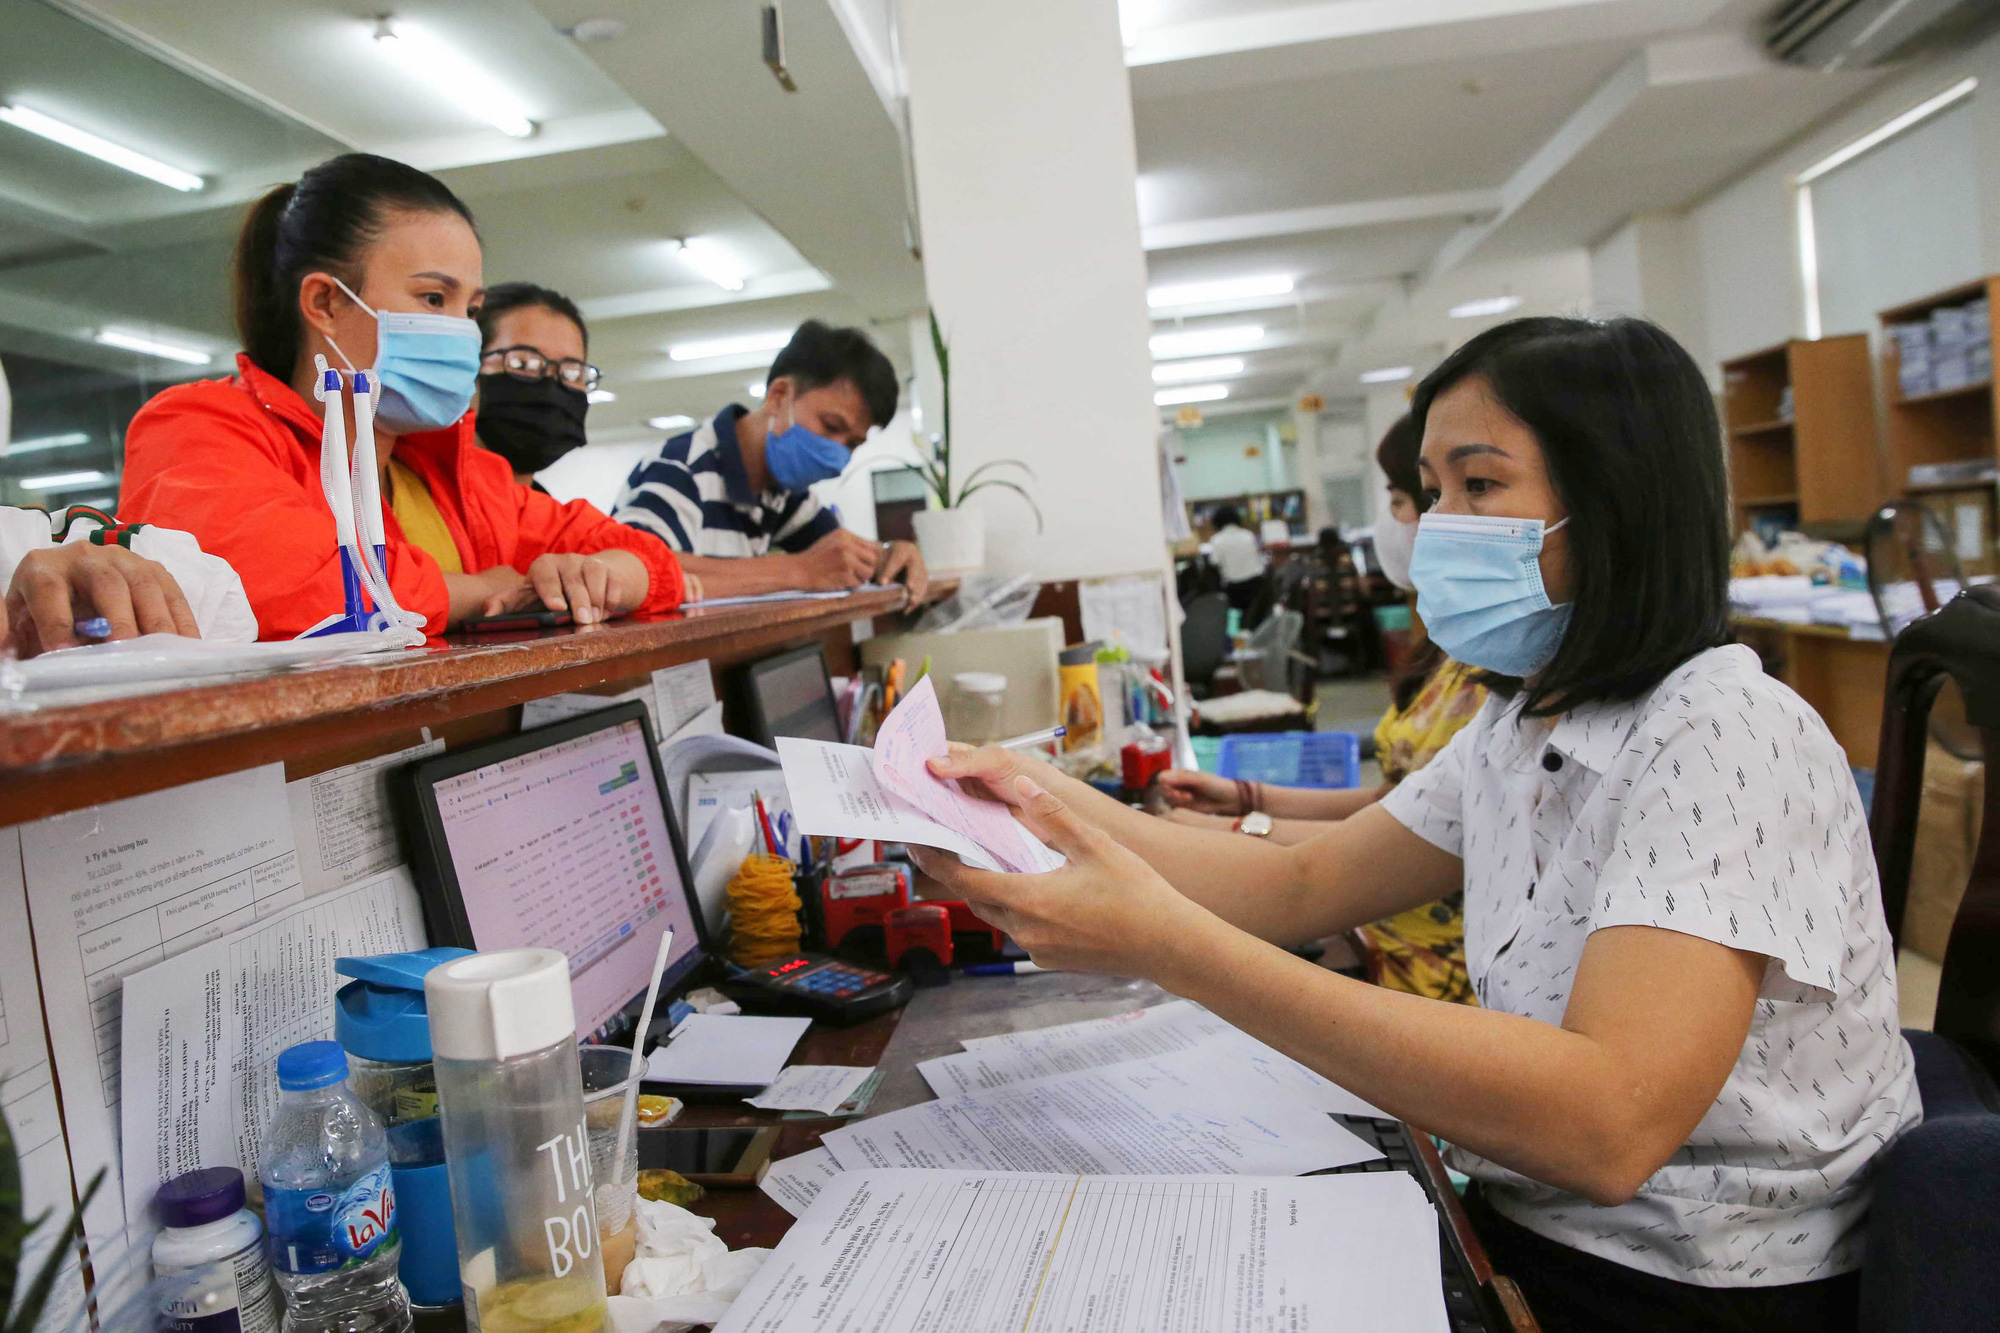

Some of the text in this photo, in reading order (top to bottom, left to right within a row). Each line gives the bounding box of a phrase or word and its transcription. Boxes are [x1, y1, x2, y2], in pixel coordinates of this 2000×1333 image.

[164, 1039, 169, 1052] VÀ
[163, 1117, 169, 1128] LÝ
[157, 1129, 163, 1142] VÀ
[163, 1155, 170, 1168] BỘ
